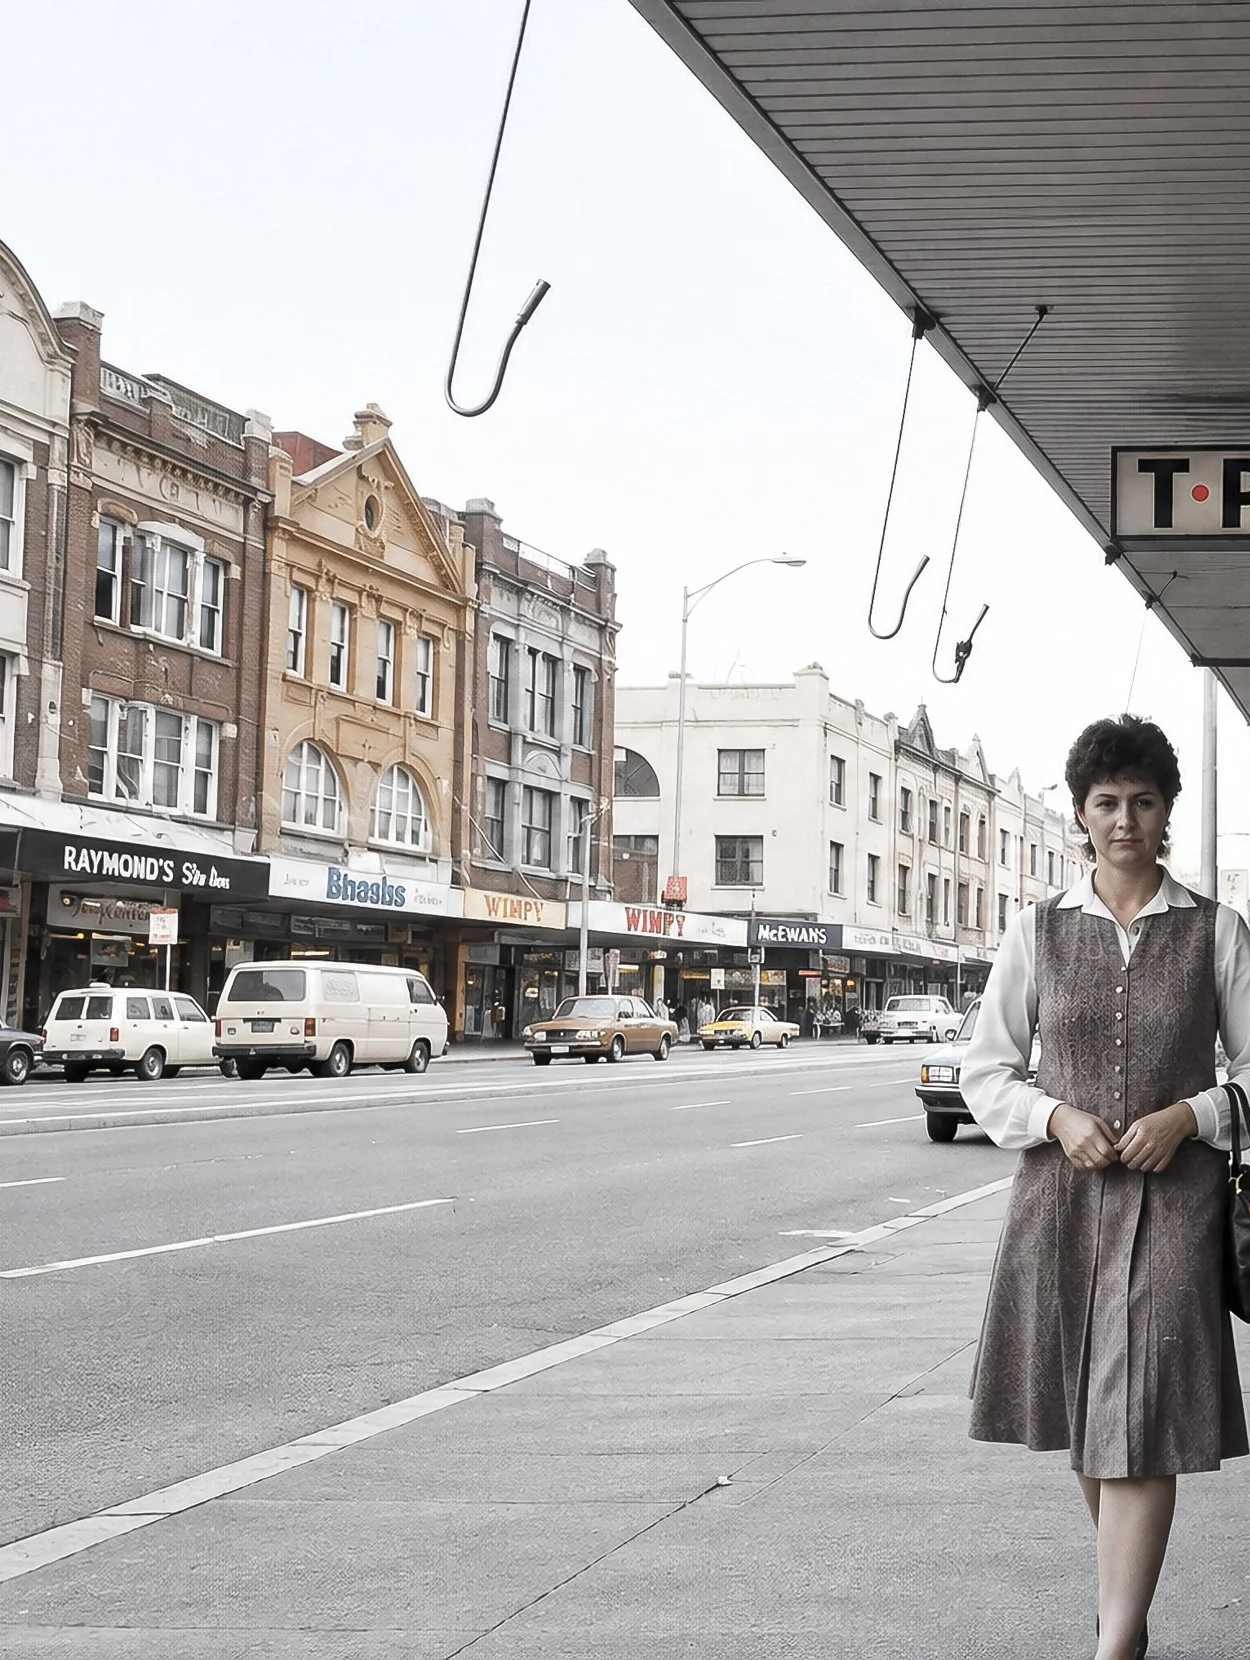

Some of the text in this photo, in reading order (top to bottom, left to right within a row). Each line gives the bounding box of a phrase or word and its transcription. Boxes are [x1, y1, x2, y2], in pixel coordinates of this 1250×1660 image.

[64, 845, 175, 883] RAYMOND'S
[483, 894, 544, 923] WIMPY
[624, 906, 686, 938] WIMPY
